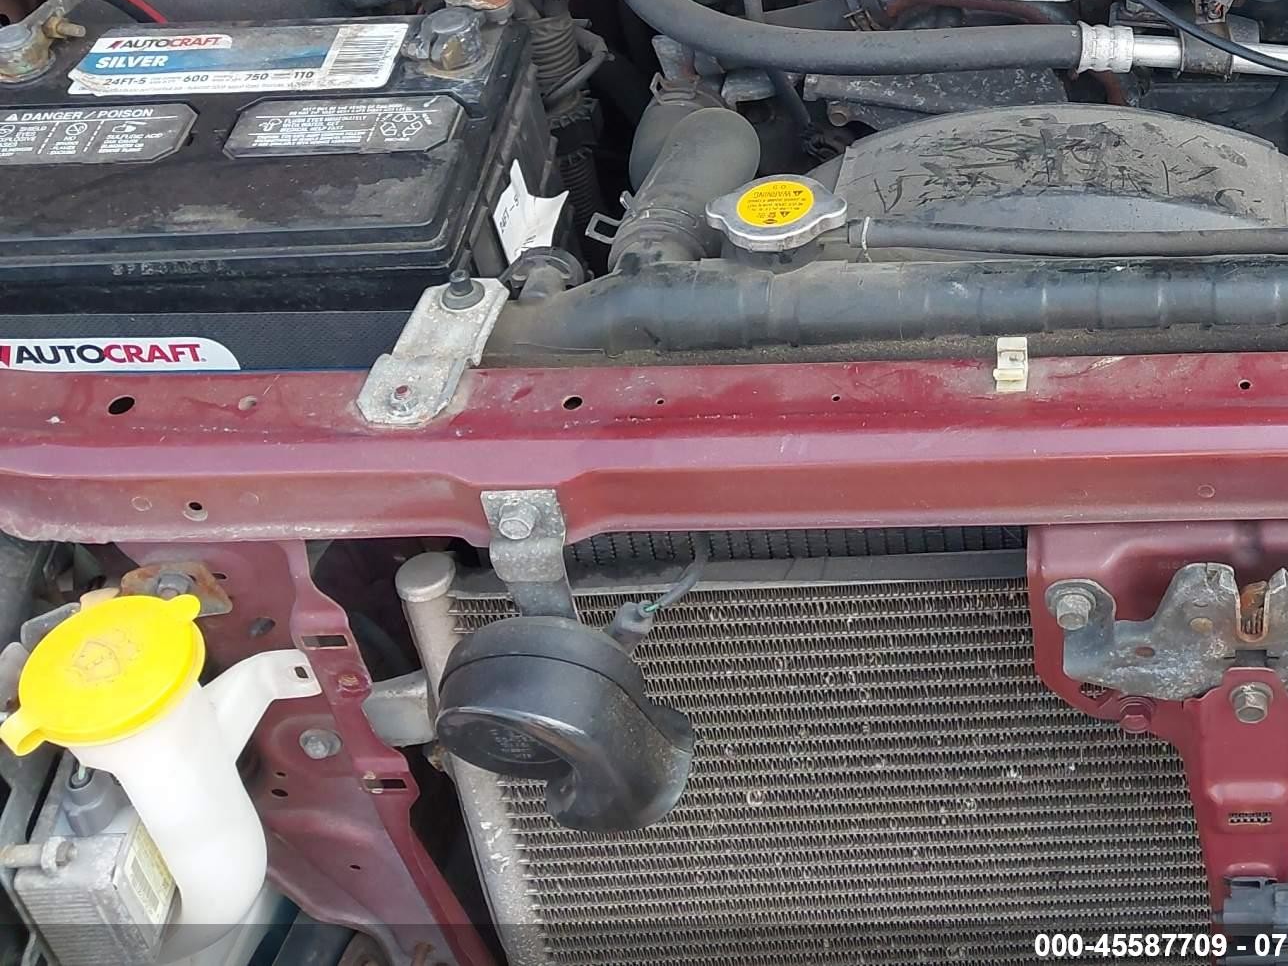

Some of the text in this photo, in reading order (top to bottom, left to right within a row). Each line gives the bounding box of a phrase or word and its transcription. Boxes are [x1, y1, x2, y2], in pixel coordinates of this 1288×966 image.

[117, 35, 223, 50] AUTOCRAFT
[95, 55, 169, 69] SILVER
[183, 75, 209, 83] 600
[244, 73, 269, 81] 750
[21, 111, 83, 121] DANGER
[97, 109, 153, 119] POISON
[16, 344, 201, 364] AUTOCRAFT
